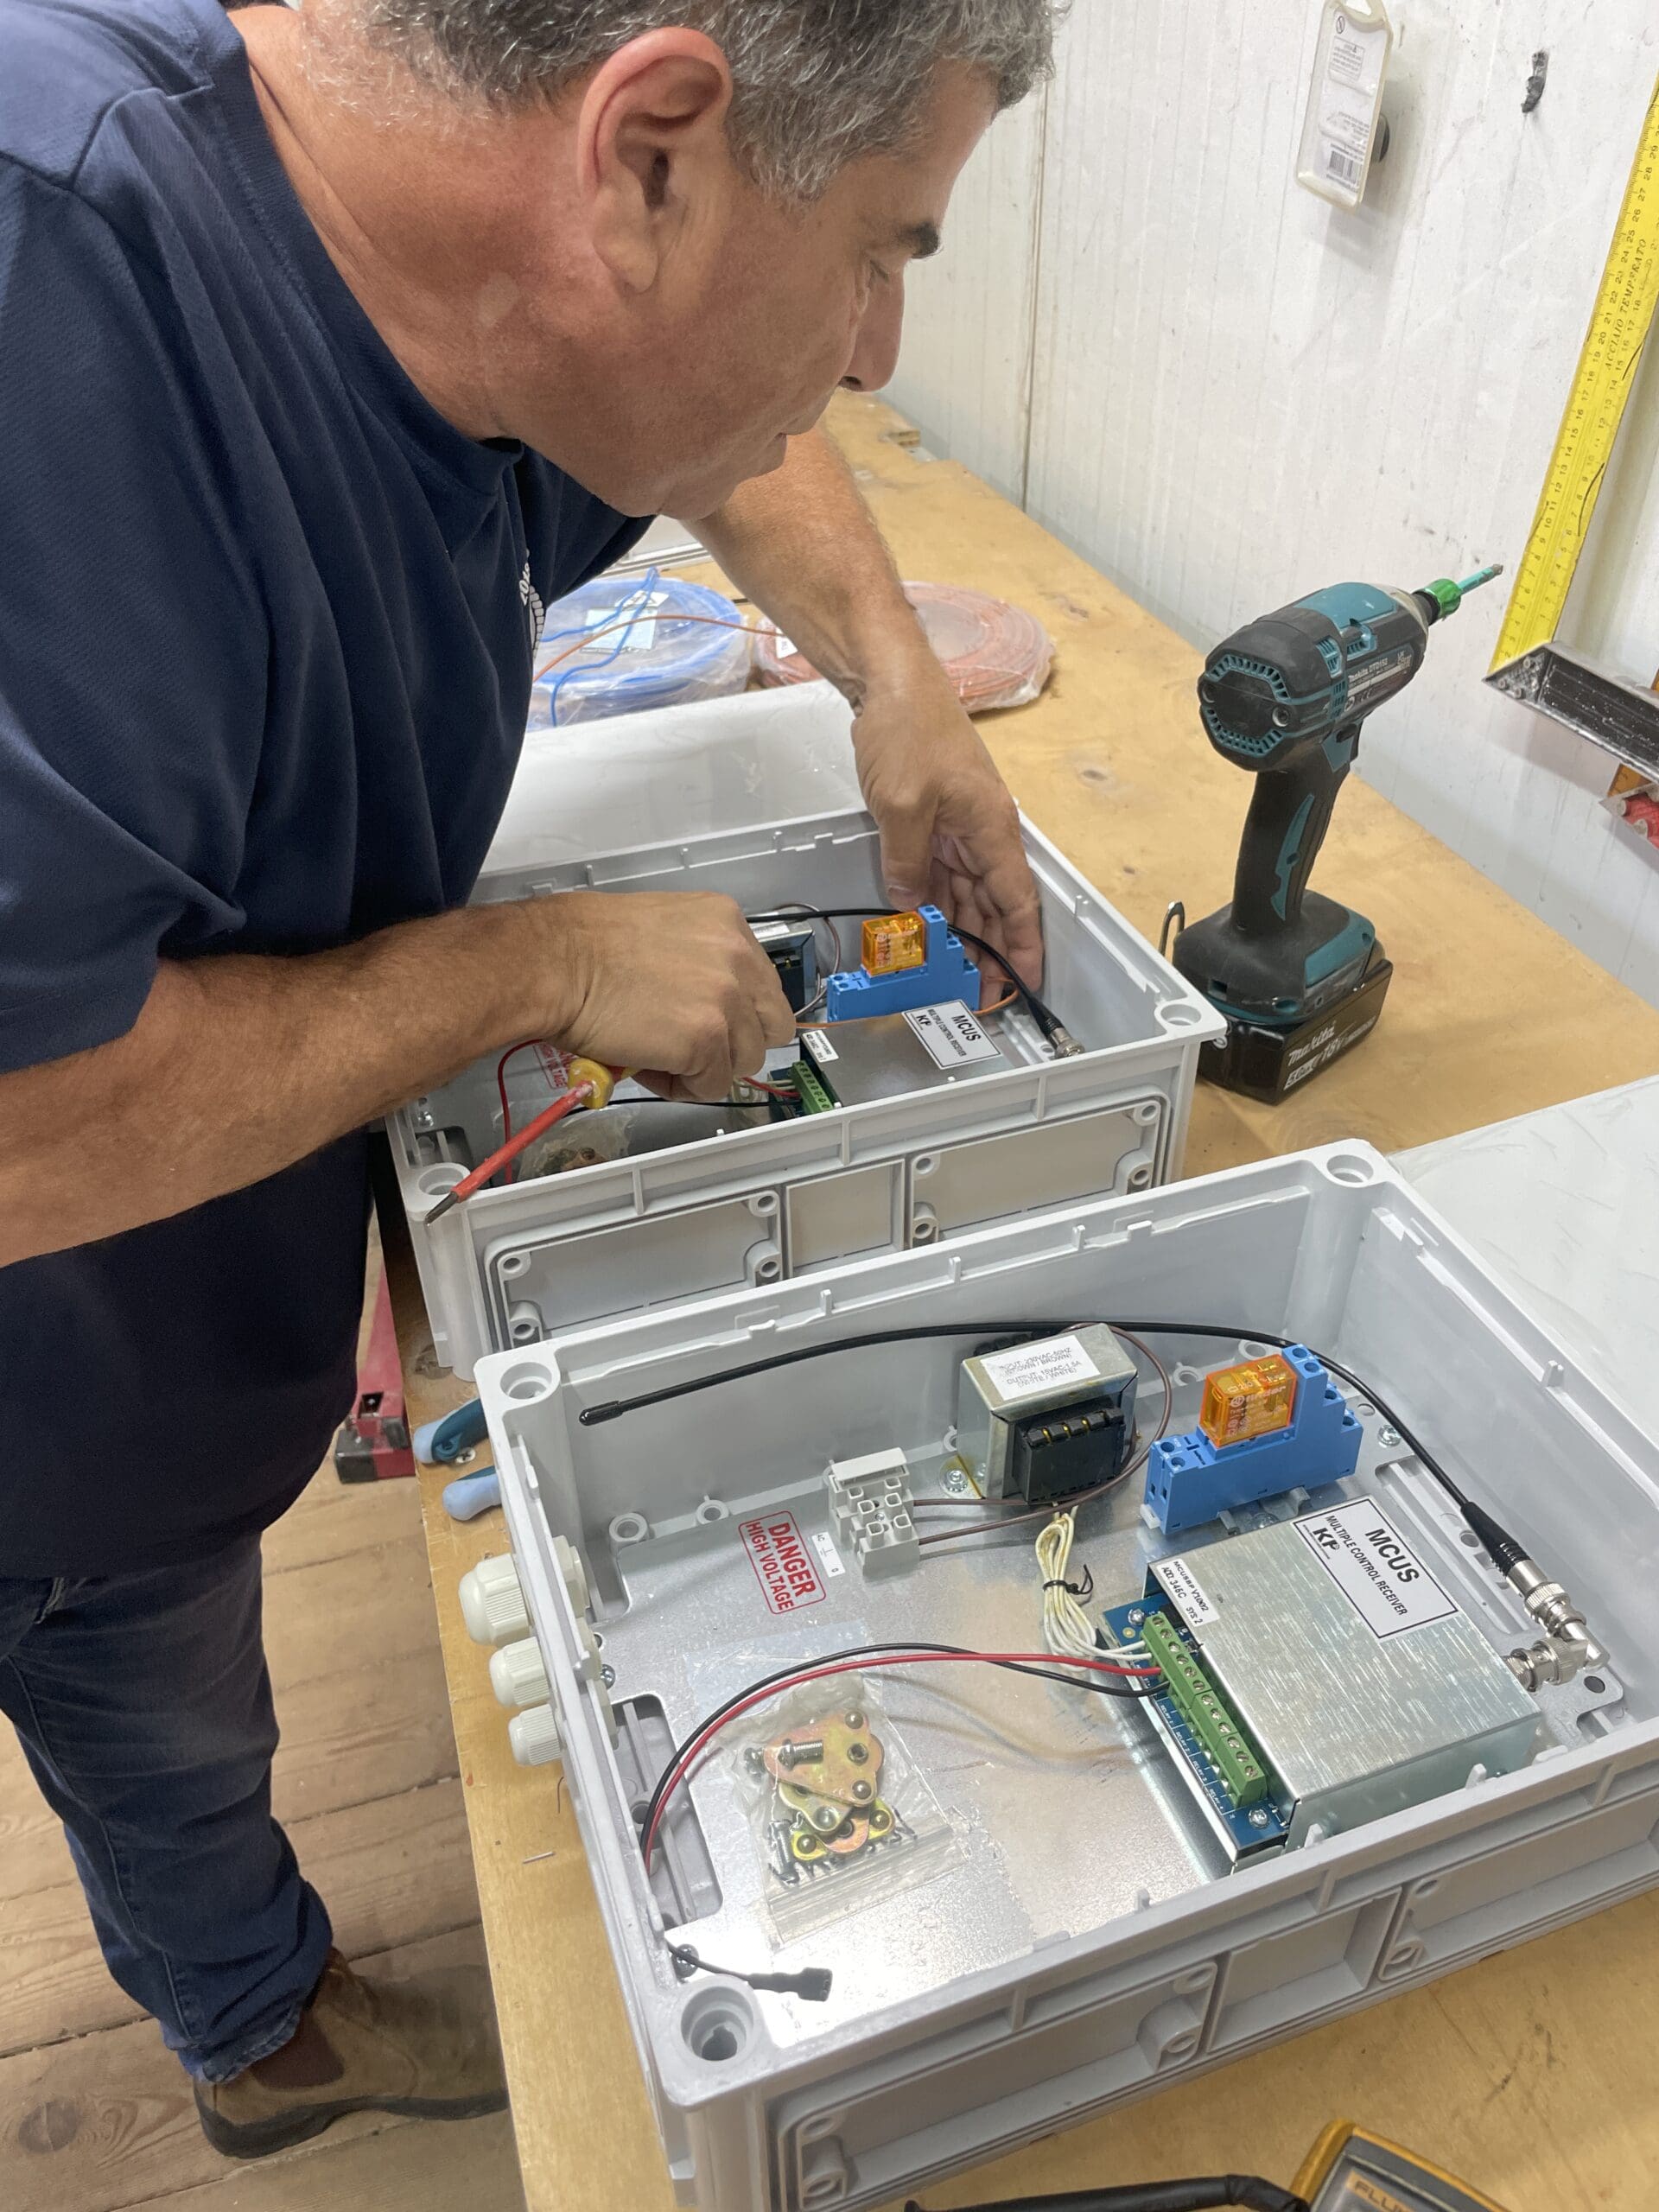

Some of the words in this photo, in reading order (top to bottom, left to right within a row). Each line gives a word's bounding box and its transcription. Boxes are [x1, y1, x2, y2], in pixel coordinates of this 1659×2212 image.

[1643, 167, 1653, 181] 28
[1637, 188, 1646, 201] 27
[1632, 208, 1641, 222] 26
[1626, 230, 1635, 244] 25
[1621, 251, 1630, 264] 24
[1609, 290, 1618, 304] 22
[1604, 312, 1612, 324] 21
[1627, 320, 1635, 331] 17
[1599, 331, 1606, 346] 20
[1605, 318, 1624, 371] ACCIAIO
[1615, 360, 1624, 372] 15
[1576, 409, 1584, 420] 16
[1570, 428, 1579, 438] 15
[1565, 447, 1573, 457] 14
[1560, 464, 1567, 475] 13
[1554, 482, 1562, 493] 12
[1549, 500, 1557, 511] 11
[1544, 518, 1552, 528] 10
[951, 1014, 982, 1042] MCUS
[1288, 1026, 1335, 1066] Makita
[767, 1522, 817, 1597] DANGER
[1364, 1528, 1420, 1583] MCUS
[746, 1522, 771, 1553] HIGH
[760, 1553, 794, 1611] VOLTAGE
[1325, 1515, 1357, 1548] MULTIPLE
[1350, 1548, 1381, 1582] CONTROL
[1376, 1580, 1408, 1616] RECEIVER
[1355, 2180, 1403, 2212] FLU
